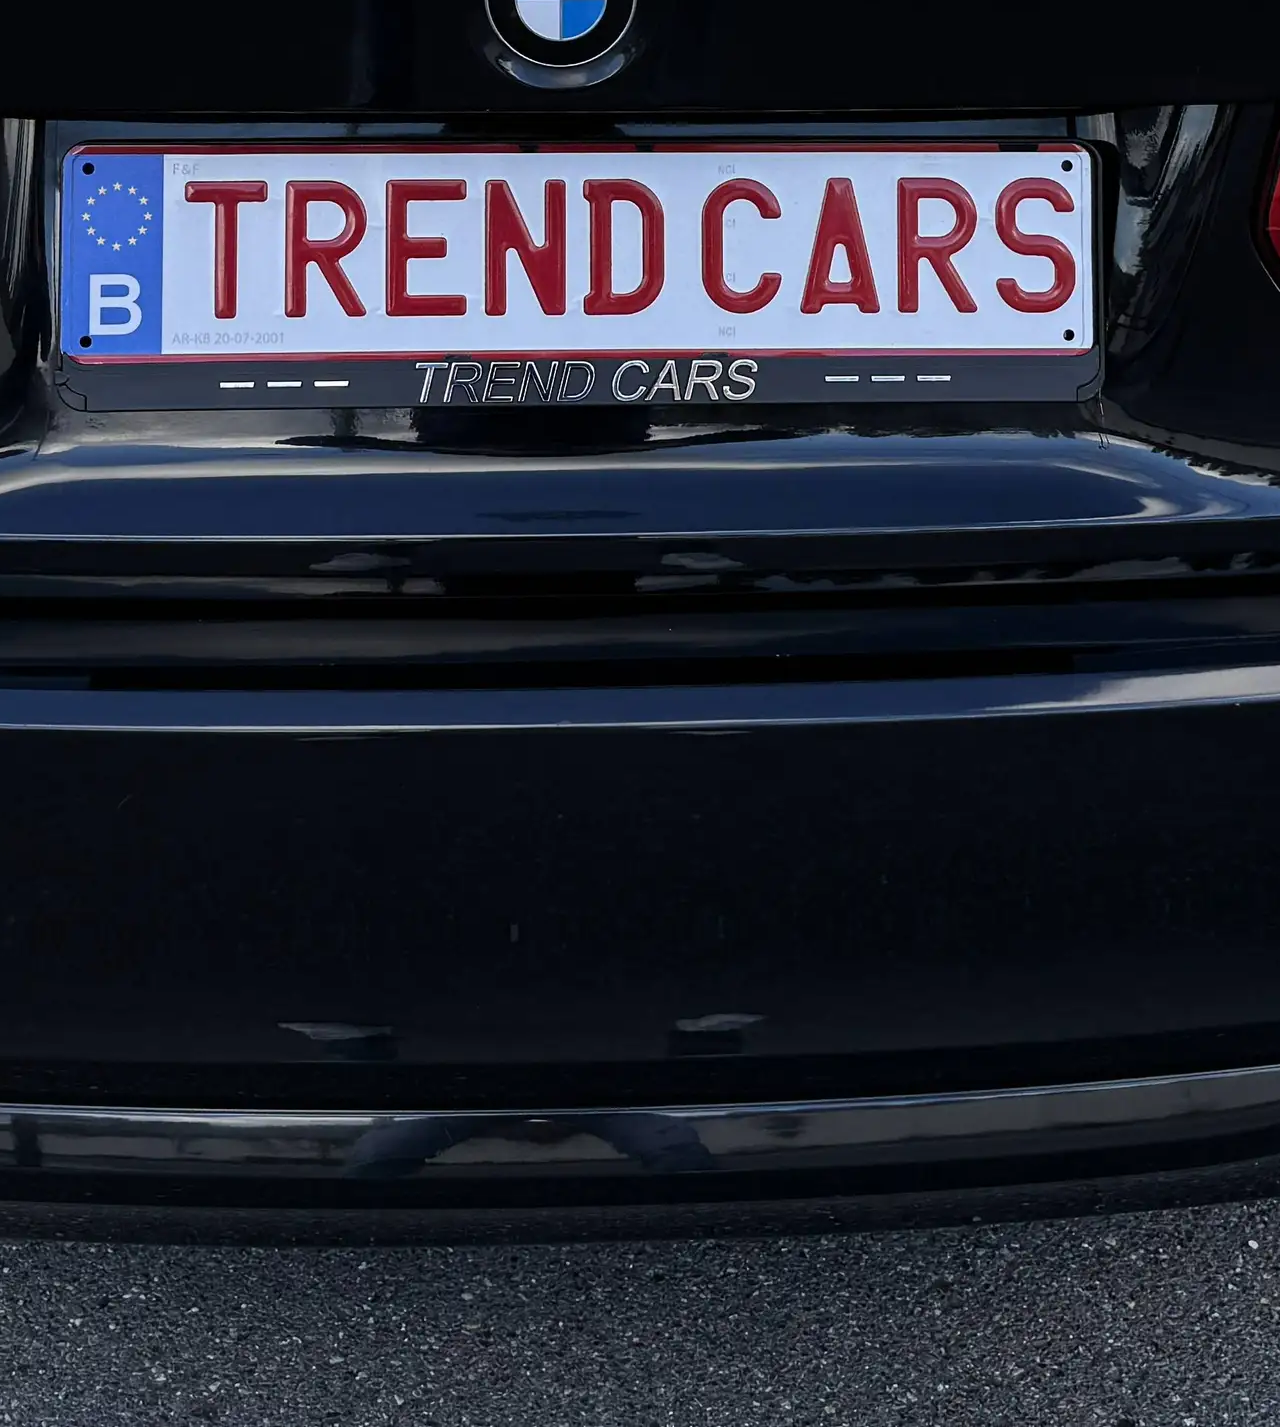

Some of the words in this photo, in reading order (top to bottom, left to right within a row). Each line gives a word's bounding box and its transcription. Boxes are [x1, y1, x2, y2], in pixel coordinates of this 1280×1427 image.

[172, 163, 200, 175] F&F
[184, 178, 666, 320] TREND
[701, 176, 1077, 314] CARS
[88, 273, 142, 337] B
[415, 361, 595, 403] TREND
[611, 359, 759, 402] CARS
